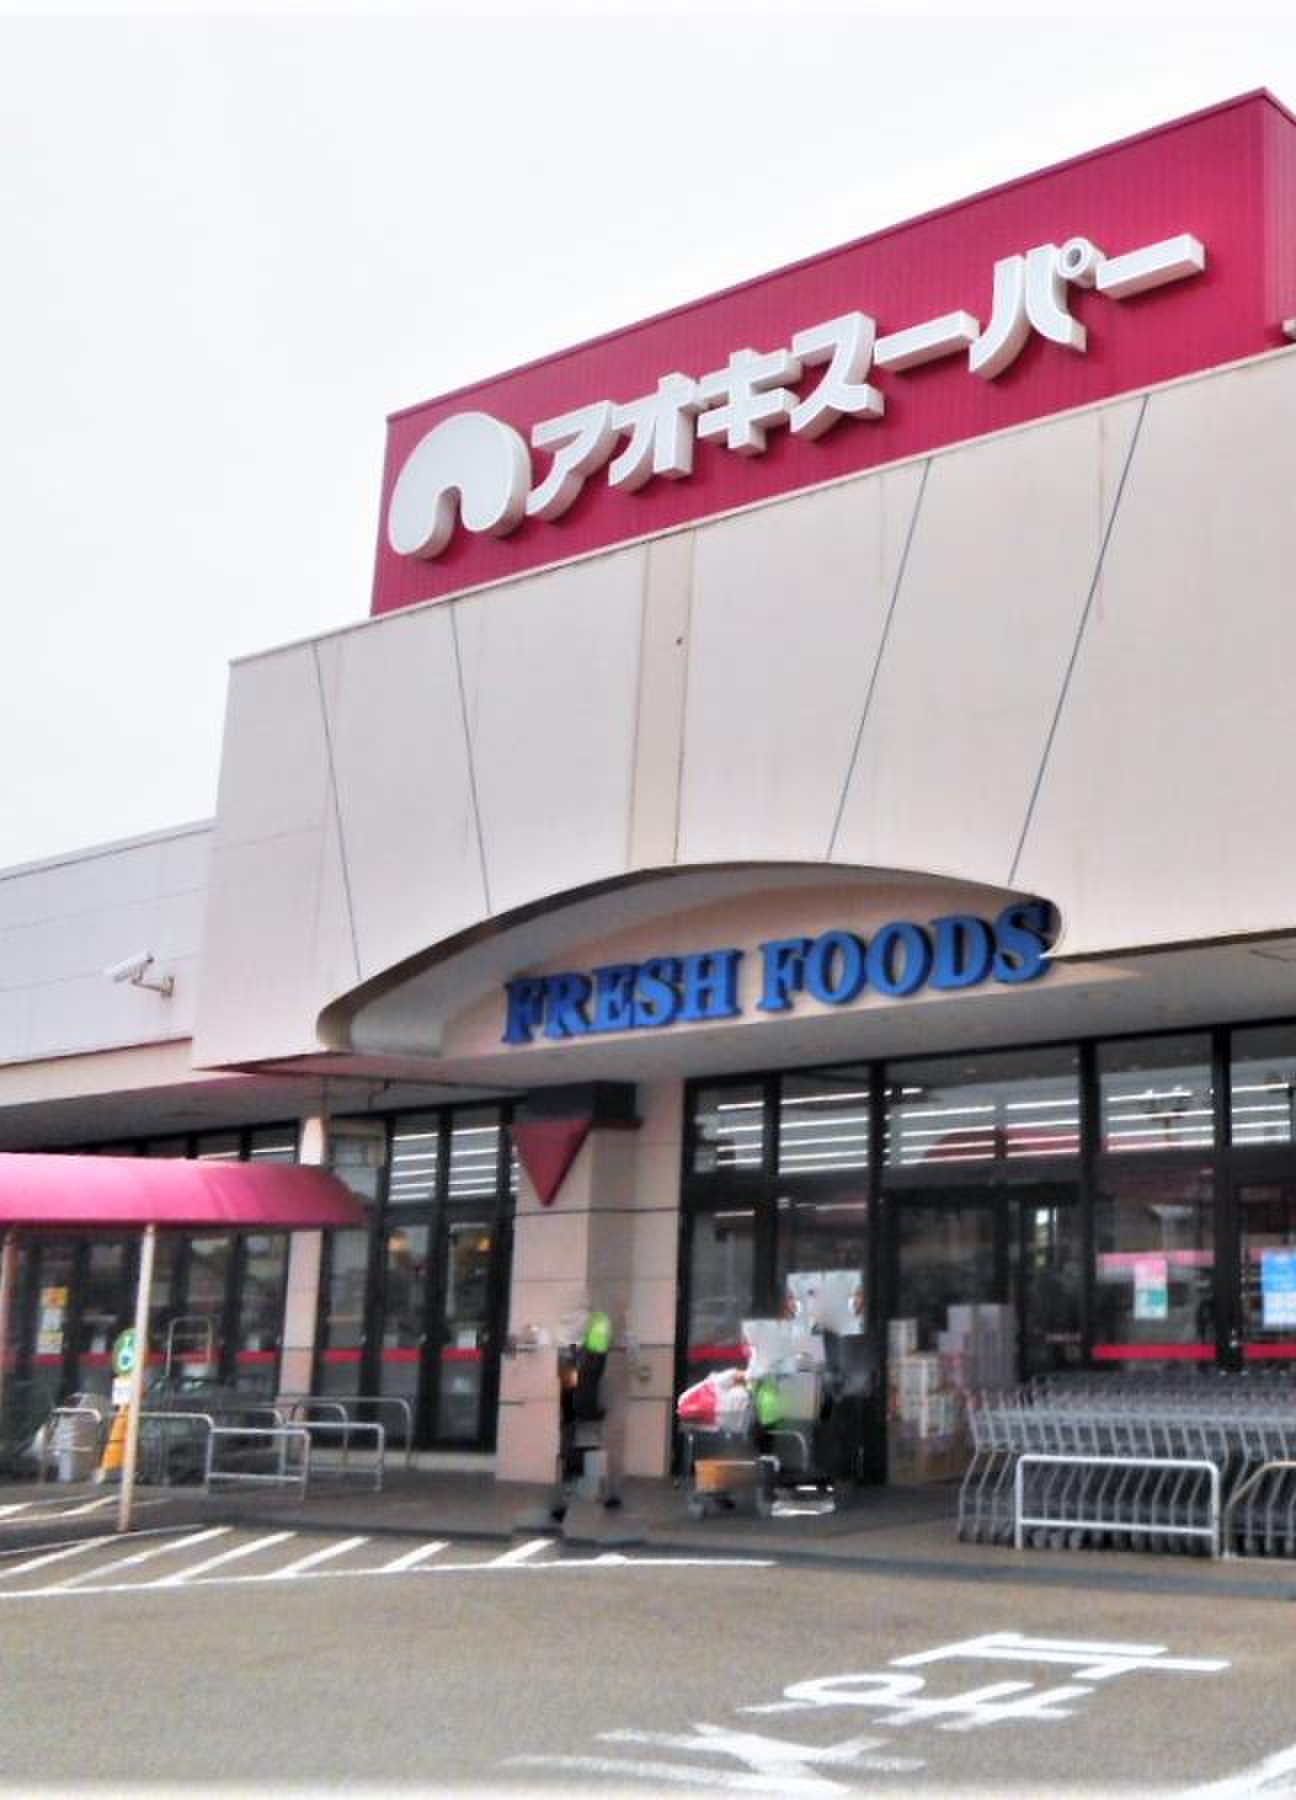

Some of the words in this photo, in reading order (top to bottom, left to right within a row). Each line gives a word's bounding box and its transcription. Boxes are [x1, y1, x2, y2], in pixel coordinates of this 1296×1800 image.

[527, 235, 1205, 517] アオキスーパー
[502, 947, 744, 1045] FRESH
[756, 900, 1056, 1013] FOODS
[500, 1631, 1232, 1795] 止まれ
